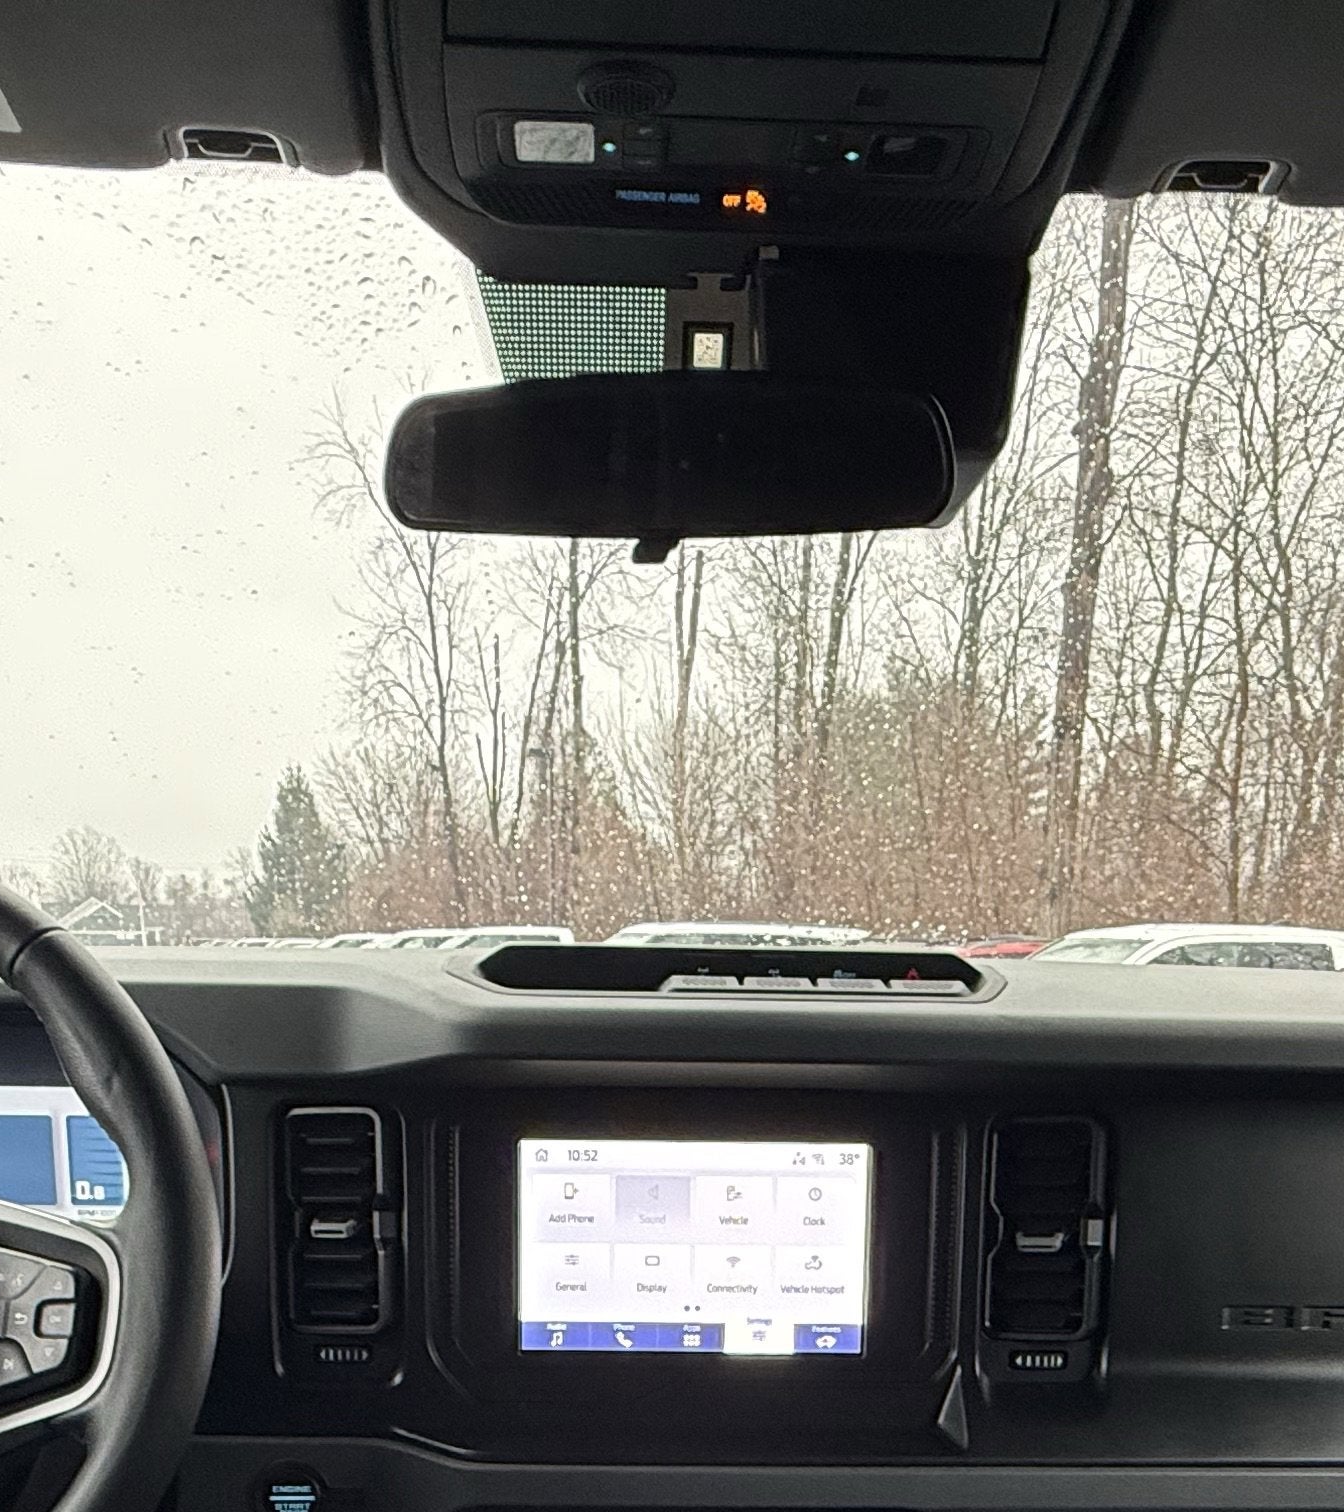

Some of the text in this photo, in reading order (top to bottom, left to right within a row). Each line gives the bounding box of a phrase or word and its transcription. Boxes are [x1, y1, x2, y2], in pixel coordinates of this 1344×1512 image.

[616, 190, 700, 204] PASSENGER AIRBAG
[722, 194, 741, 207] OFF
[568, 1150, 598, 1162] 10:52
[549, 1214, 594, 1224] Add Phone
[639, 1214, 666, 1225] Sound
[719, 1216, 749, 1226] Vehicle
[803, 1216, 826, 1226] Clock
[555, 1281, 587, 1292] General
[637, 1283, 667, 1294] Display
[707, 1284, 758, 1295] Connectivity
[781, 1284, 845, 1295] Vehicle Hotspot
[272, 1485, 312, 1493] ENGINE
